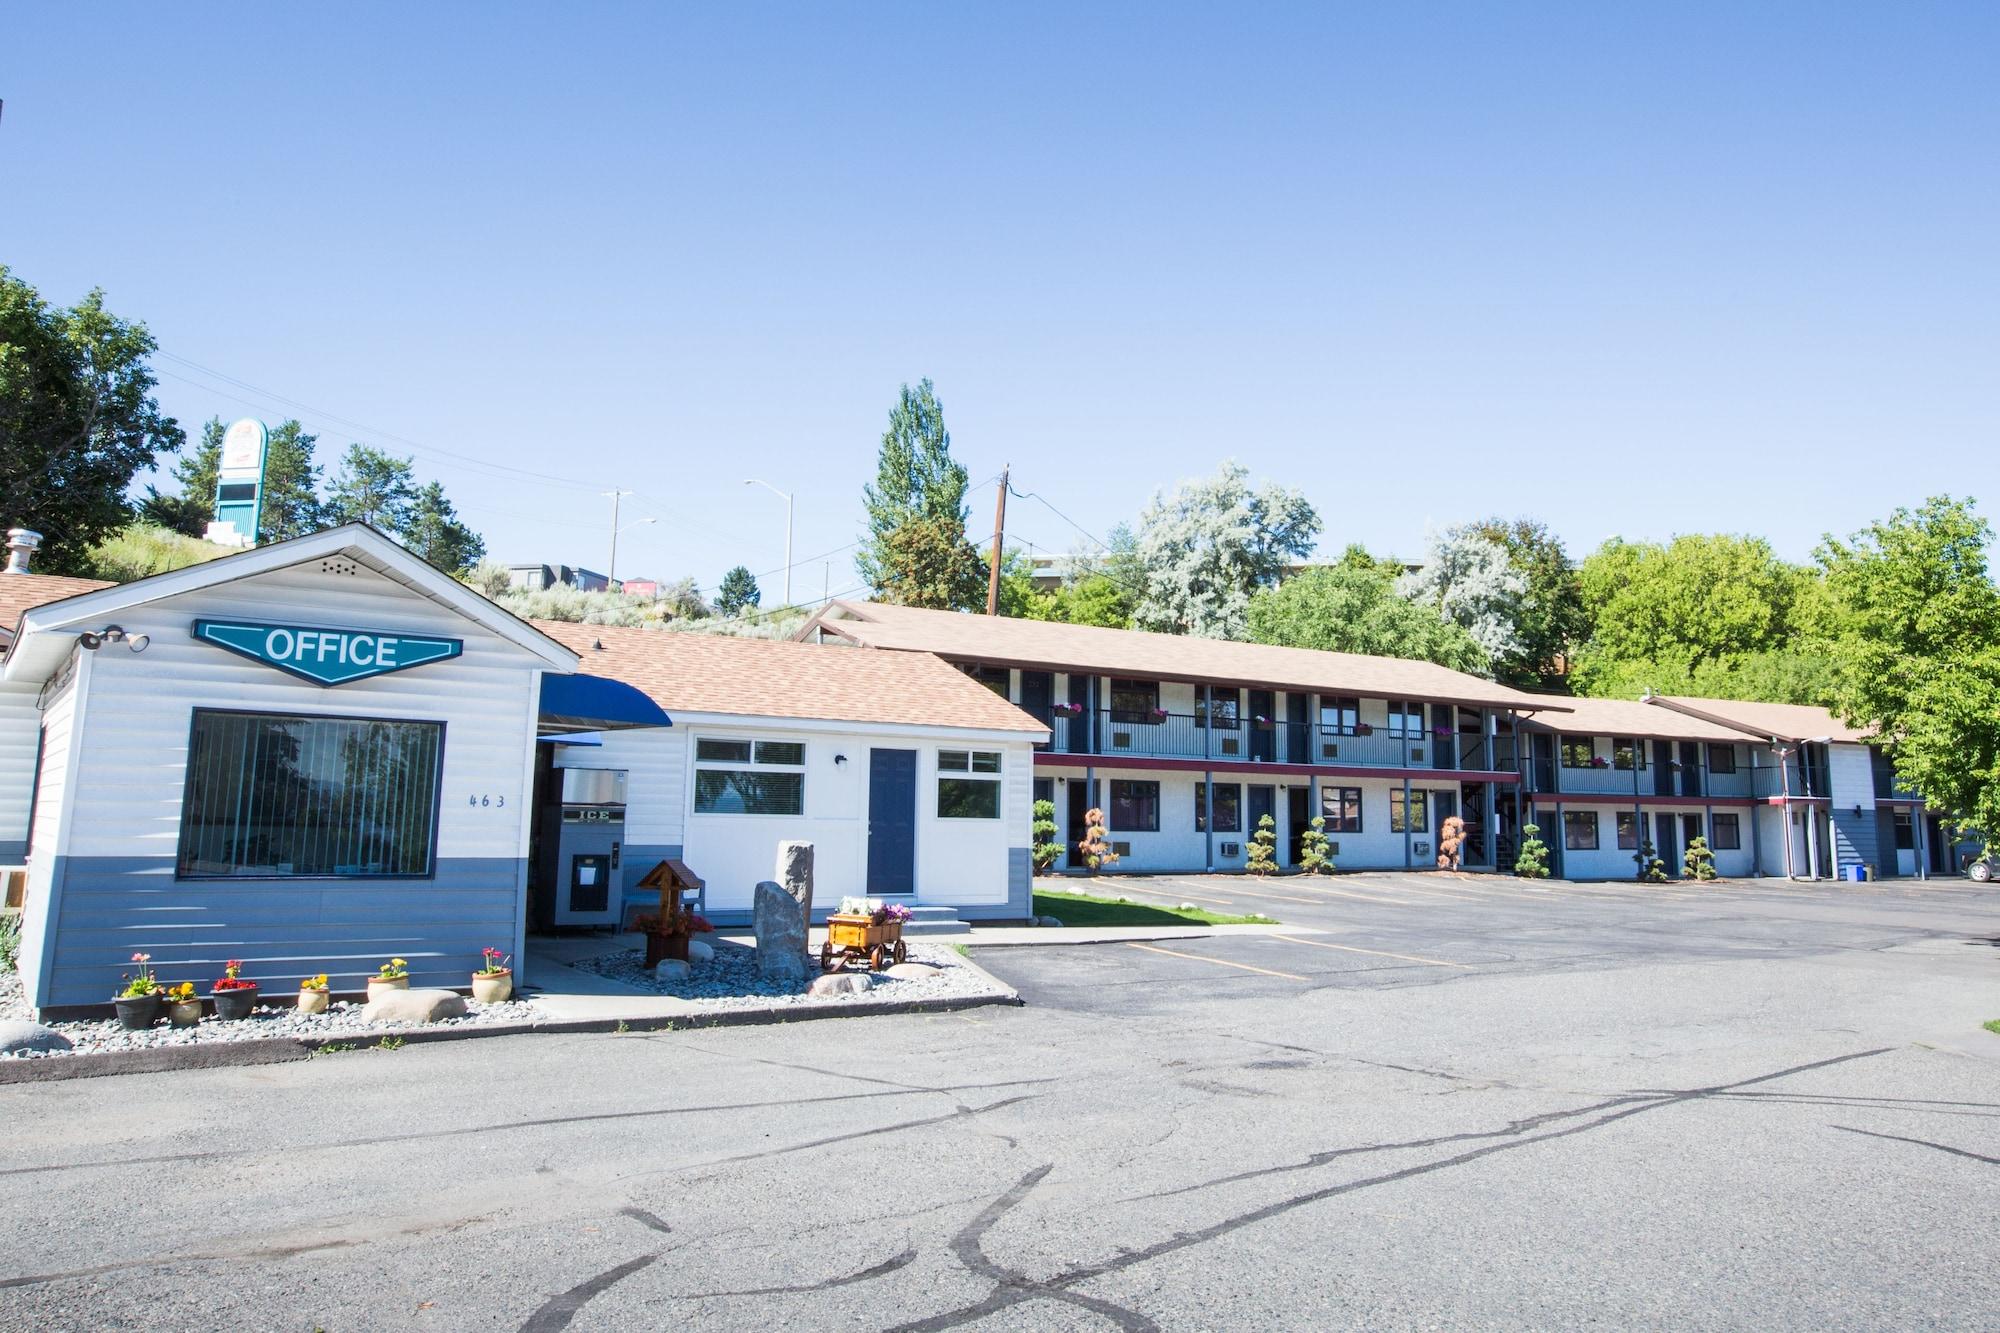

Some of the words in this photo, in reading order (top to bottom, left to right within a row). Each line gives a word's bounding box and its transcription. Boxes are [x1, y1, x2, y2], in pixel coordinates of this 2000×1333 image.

[266, 629, 398, 666] OFFICE
[469, 794, 504, 807] 463
[579, 810, 609, 819] ICE
